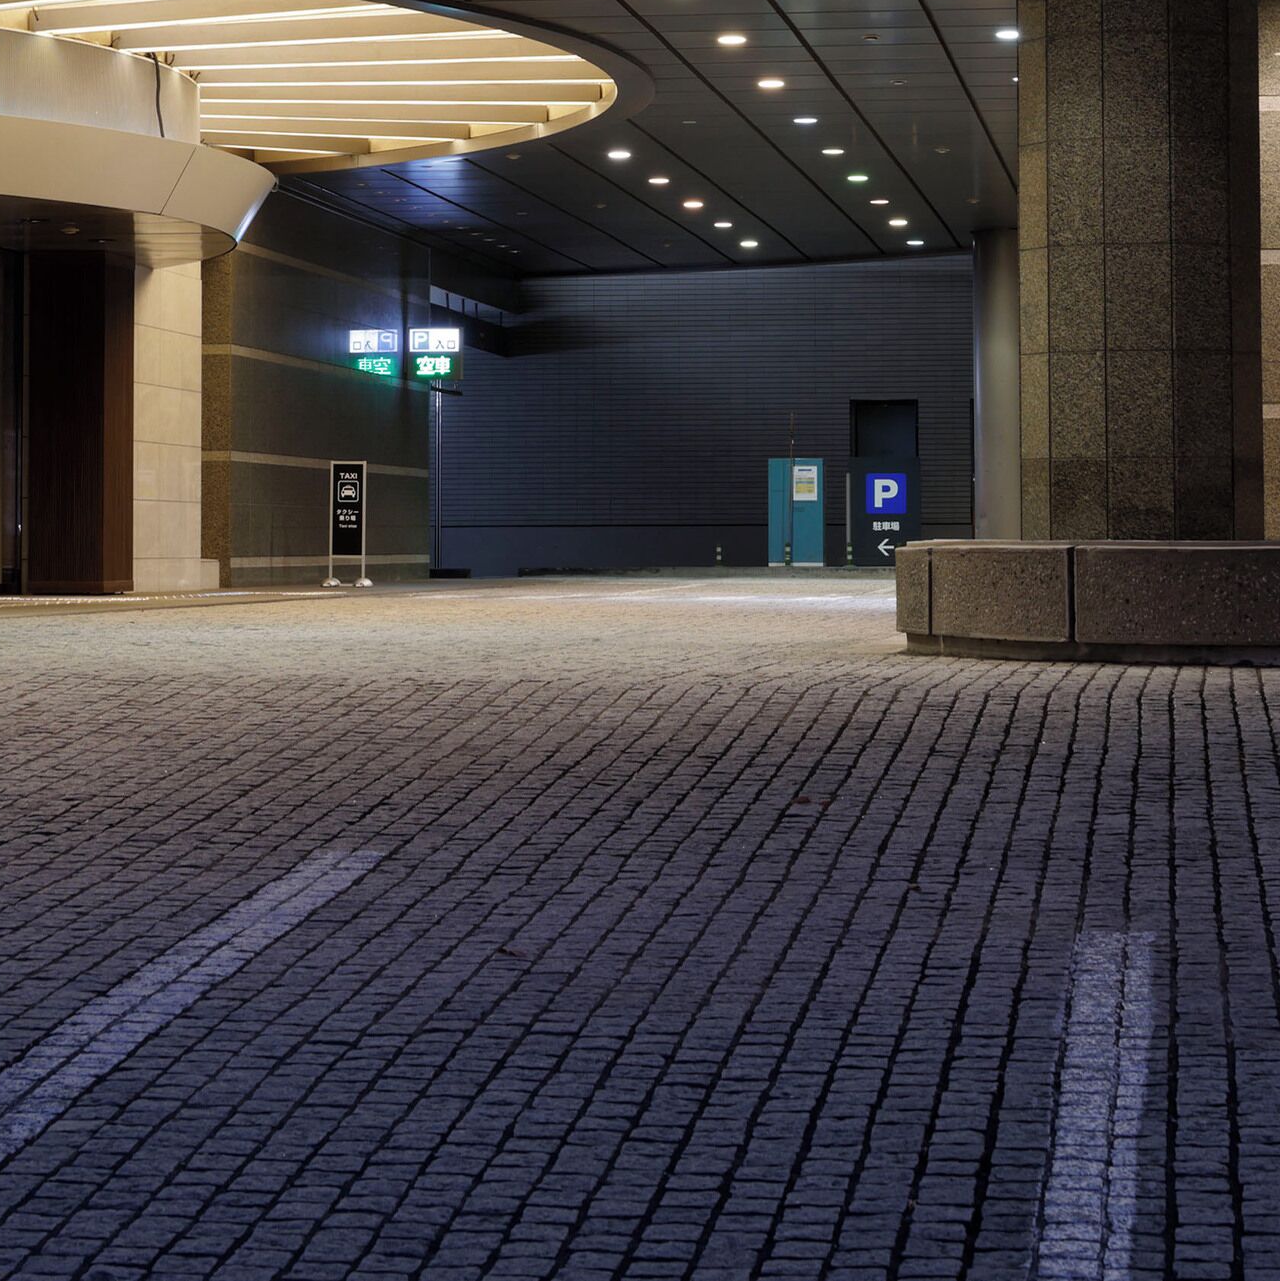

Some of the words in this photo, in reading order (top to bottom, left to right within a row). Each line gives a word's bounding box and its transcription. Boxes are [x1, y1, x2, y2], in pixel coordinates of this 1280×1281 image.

[414, 332, 428, 349] P
[435, 340, 456, 350] 入口
[416, 355, 451, 375] 空車
[874, 479, 899, 508] P
